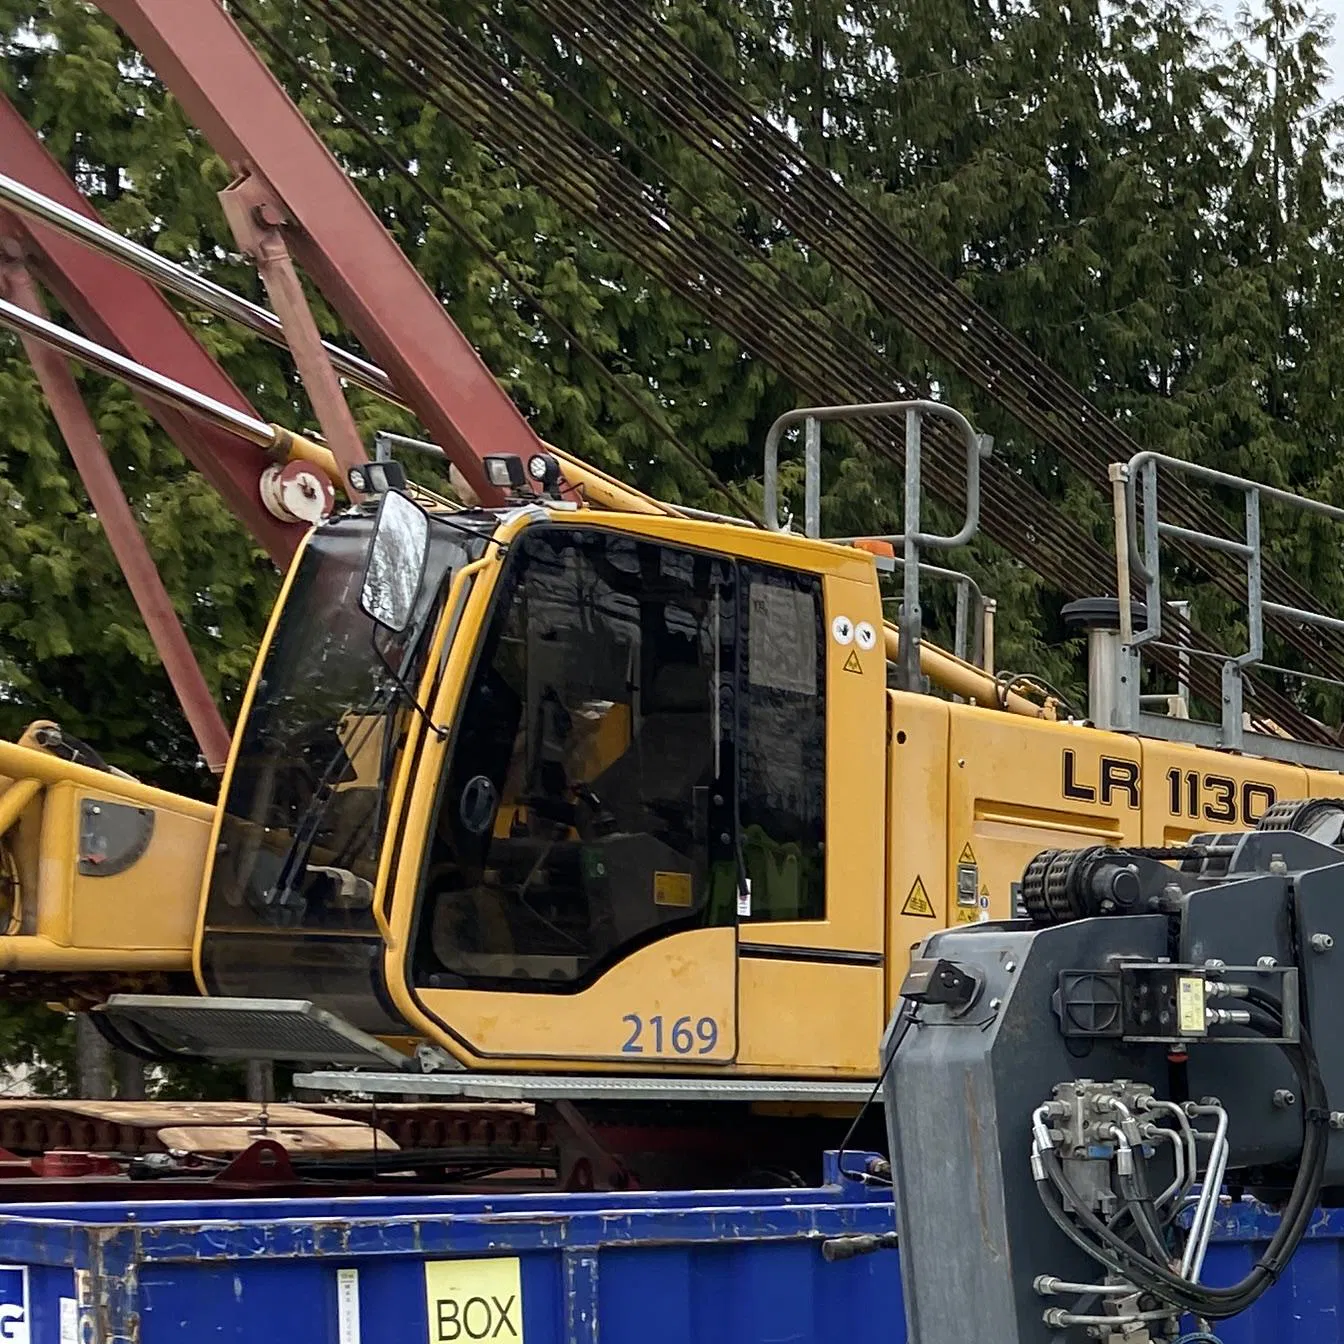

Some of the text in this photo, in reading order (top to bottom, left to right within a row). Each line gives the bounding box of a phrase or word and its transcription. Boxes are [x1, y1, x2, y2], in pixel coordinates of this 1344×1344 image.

[1063, 749, 1277, 827] LR 1130
[622, 1014, 717, 1054] 2169
[437, 1295, 518, 1341] BOX
